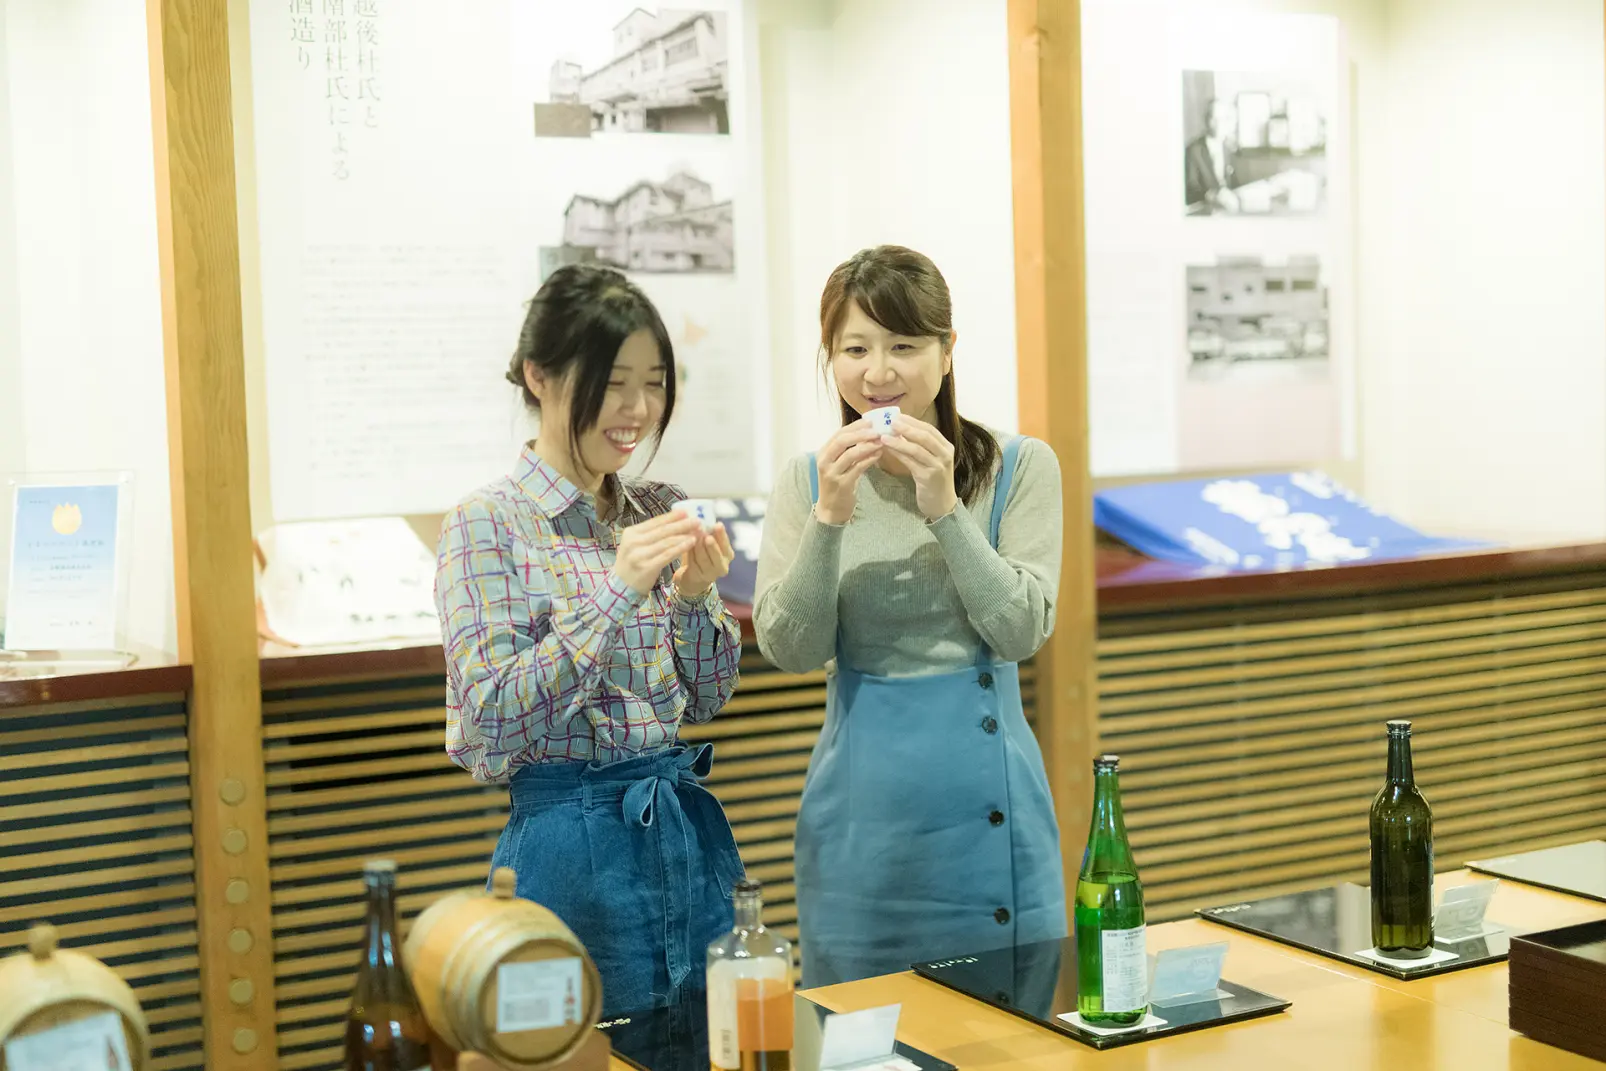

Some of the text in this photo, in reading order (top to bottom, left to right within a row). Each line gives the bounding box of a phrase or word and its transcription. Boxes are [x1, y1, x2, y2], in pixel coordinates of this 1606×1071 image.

[323, 0, 350, 181] 南部杜氏による
